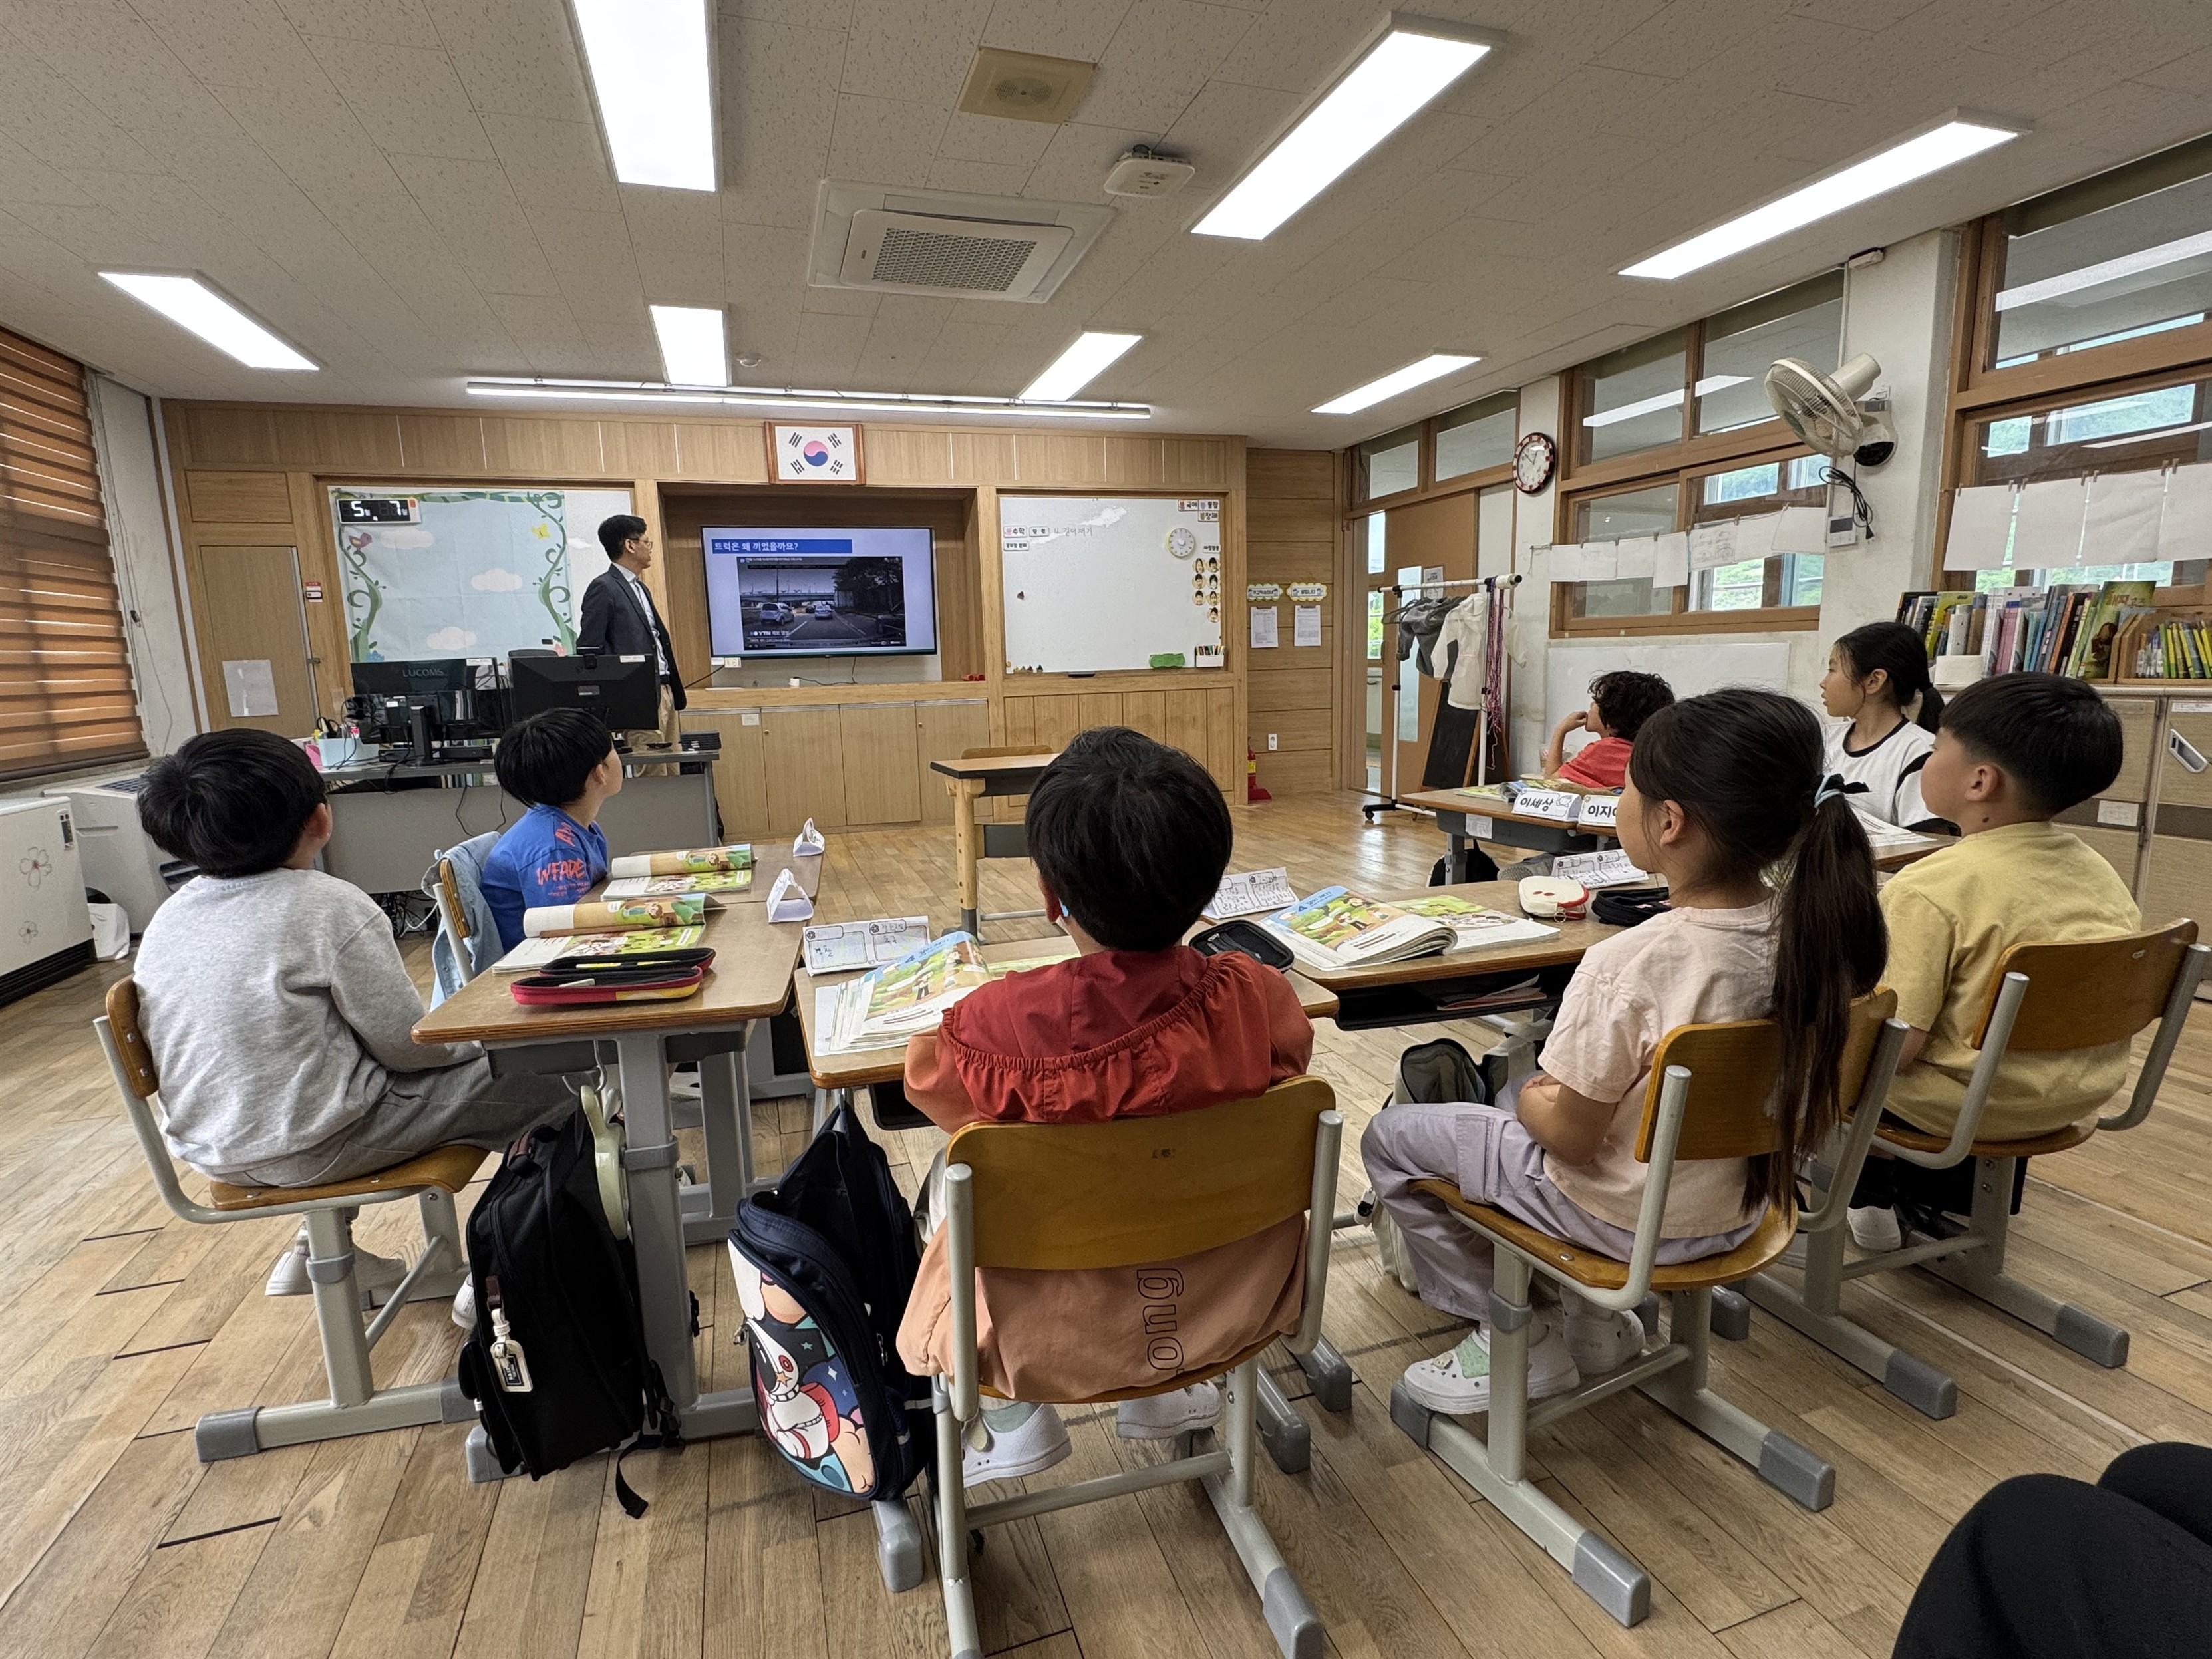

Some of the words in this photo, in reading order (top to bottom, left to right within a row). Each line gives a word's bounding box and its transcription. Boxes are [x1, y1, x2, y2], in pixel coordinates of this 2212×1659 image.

[714, 542, 740, 551] 트럭은
[742, 542, 750, 551] 왜
[402, 668, 445, 677] LUCOMS
[1520, 798, 1553, 812] 이세상
[1136, 1267, 1184, 1376] ong
